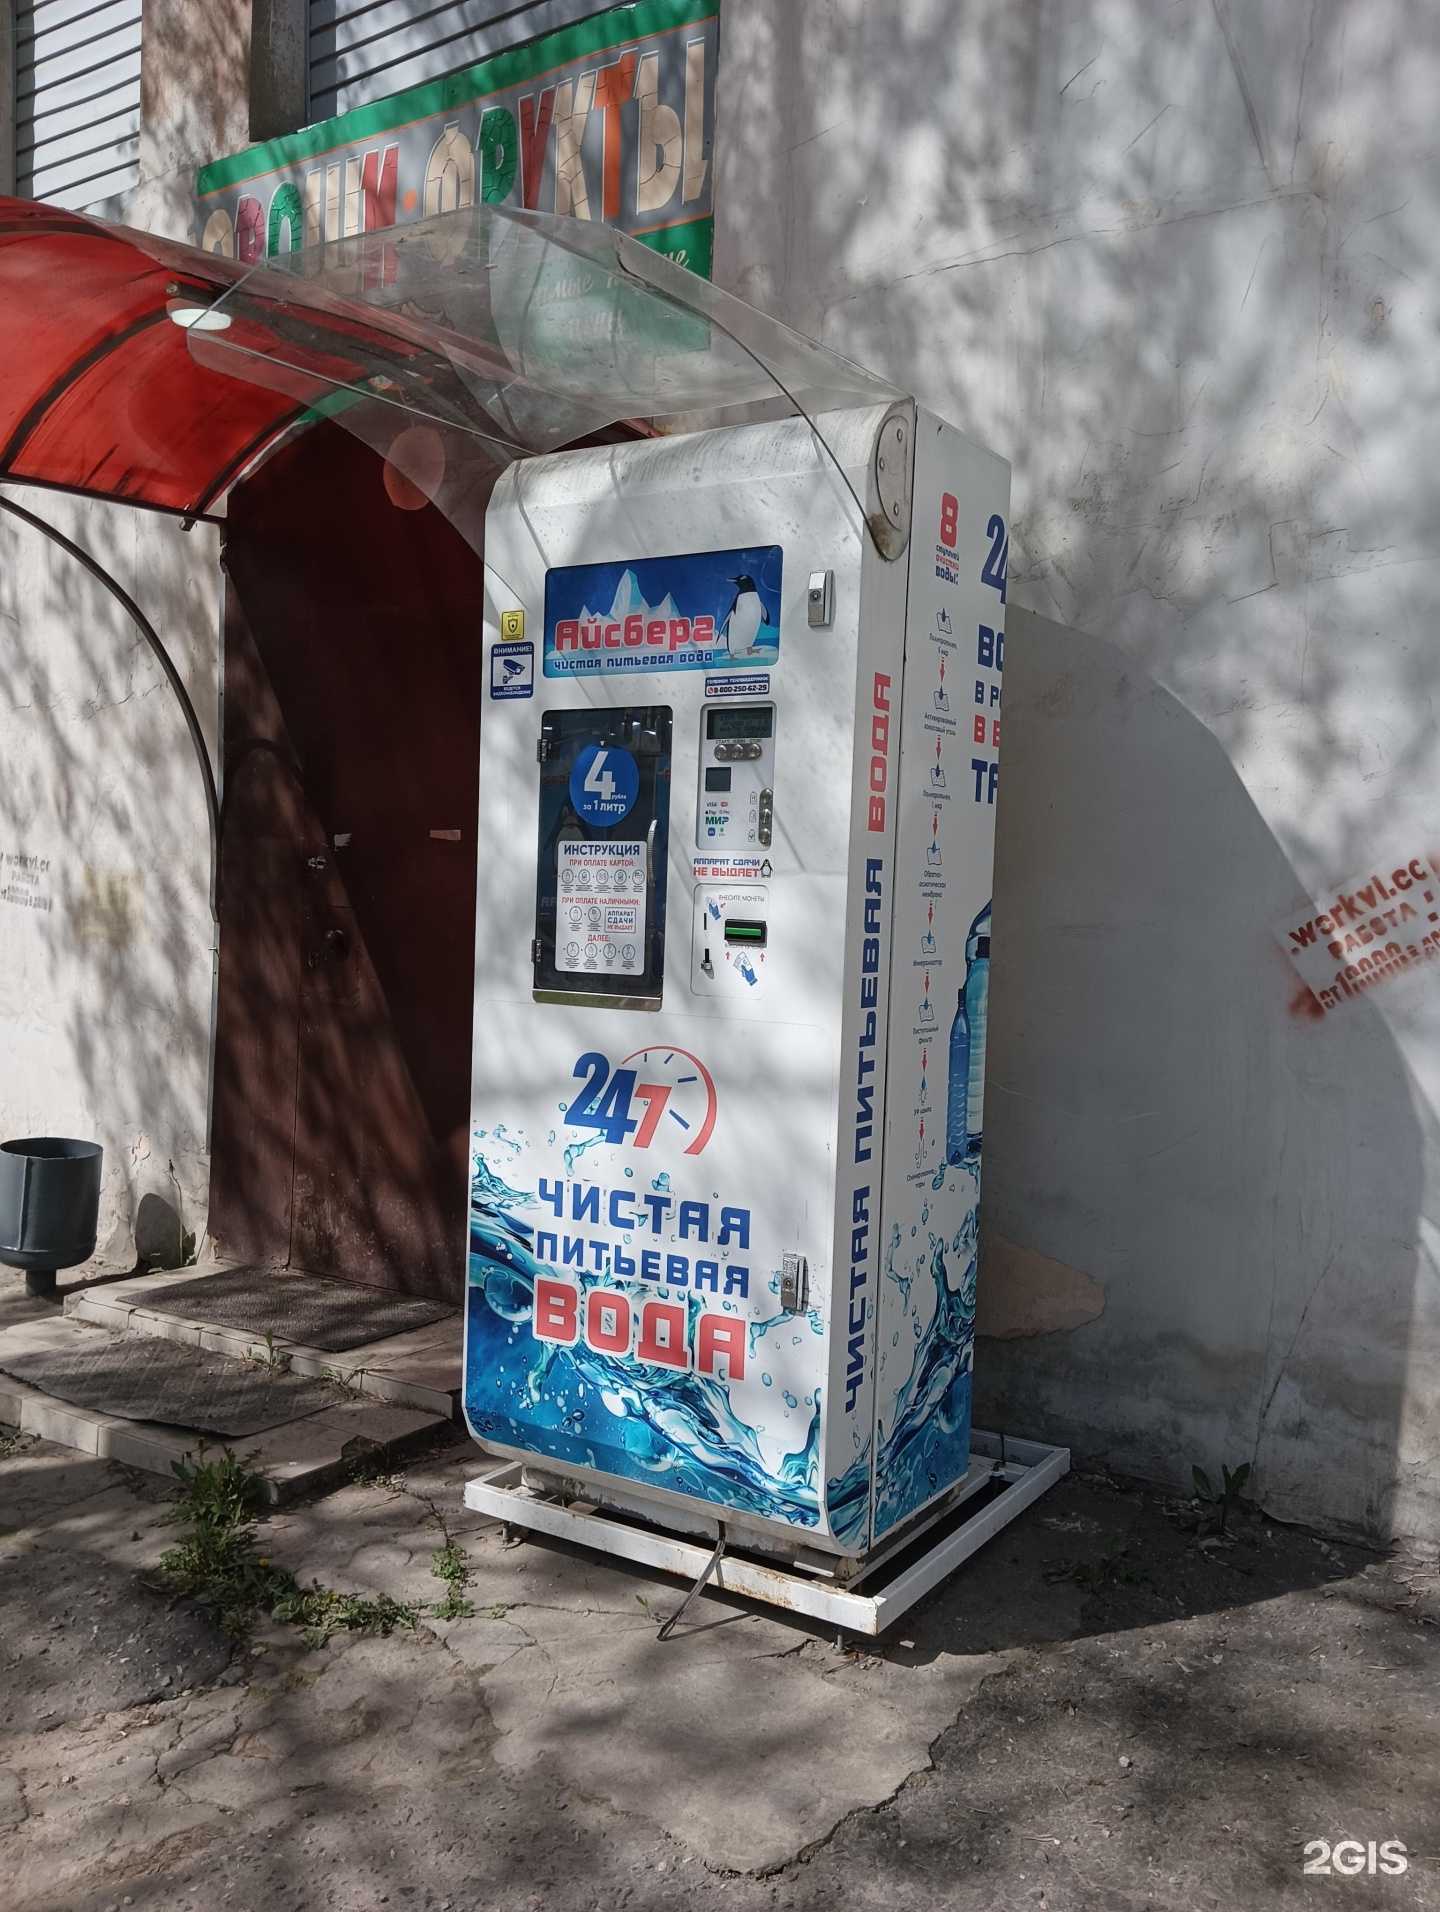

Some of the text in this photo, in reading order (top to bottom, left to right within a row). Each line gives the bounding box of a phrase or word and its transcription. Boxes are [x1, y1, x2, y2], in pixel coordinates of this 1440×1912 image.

[941, 491, 959, 548] 8
[555, 614, 716, 652] Айсберг
[553, 648, 714, 671] чистая питьевая вода
[974, 680, 985, 705] В
[974, 714, 986, 744] В
[584, 751, 616, 800] 4
[593, 800, 599, 811] 1
[600, 803, 626, 814] литр
[705, 816, 729, 825] МИР
[564, 844, 640, 857] ИНСТРУКЦИЯ
[583, 859, 607, 867] ОПЛАТЕ
[693, 867, 760, 877] НЕ ВЫДАЕТ
[845, 671, 892, 1413] ЧИСТАЯ ПИТЬЕВАЯ ВОДА
[538, 1177, 751, 1250] ЧИСТАЯ
[536, 1230, 750, 1299] ПИТЬЕВАЯ
[535, 1278, 747, 1382] ВОДА
